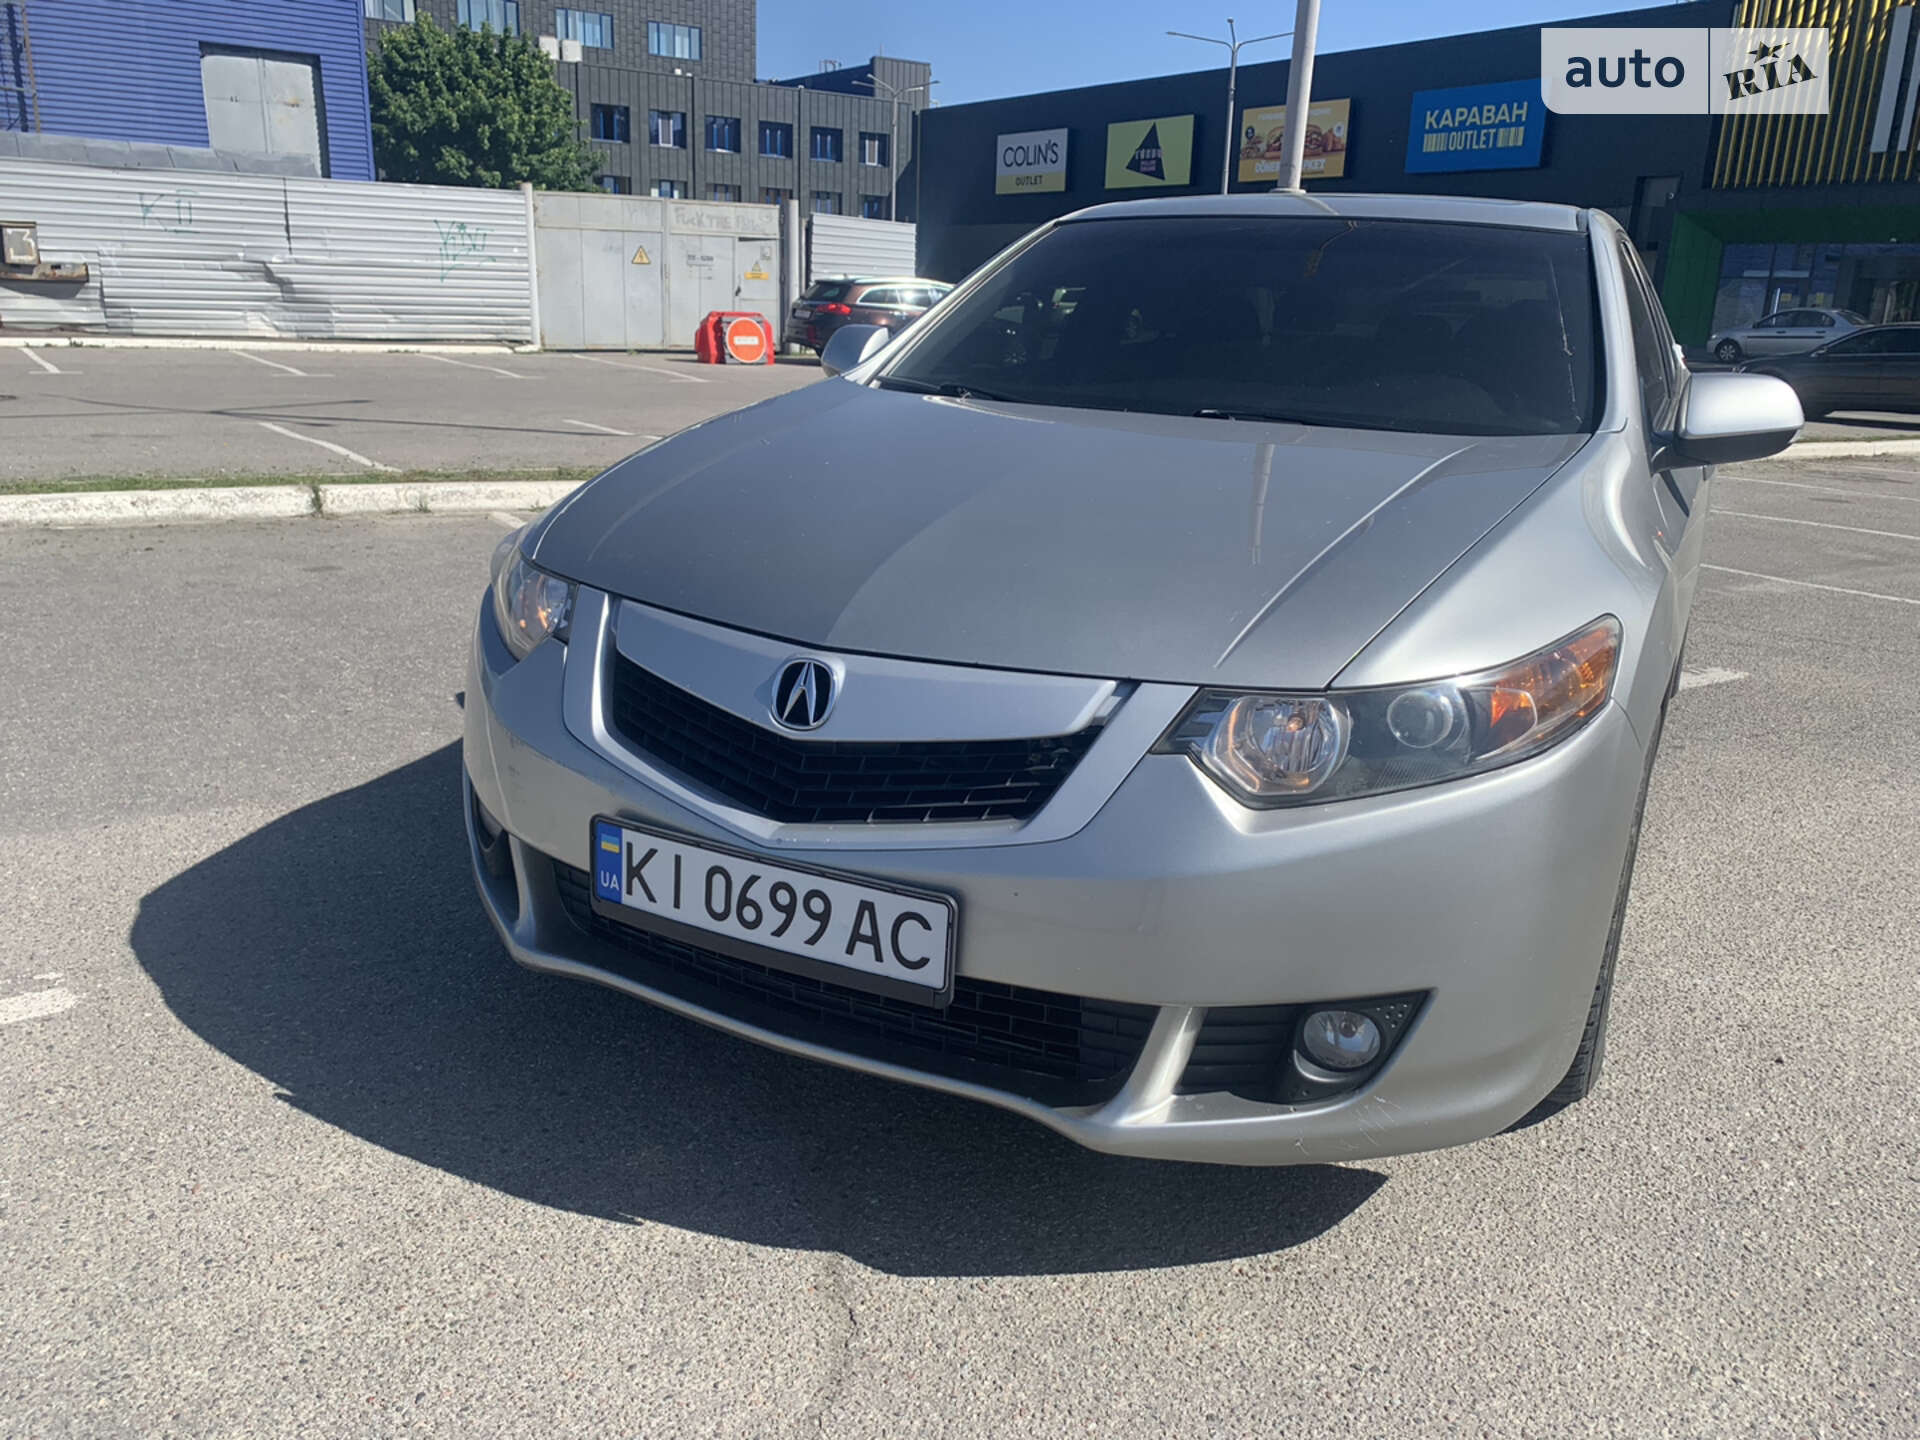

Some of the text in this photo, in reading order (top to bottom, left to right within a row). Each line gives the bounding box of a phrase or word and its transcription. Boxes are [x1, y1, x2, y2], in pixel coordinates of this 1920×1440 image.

[1425, 101, 1528, 130] КАРАВАН
[1448, 128, 1497, 151] OUTLET
[1003, 139, 1059, 168] COLIN'S
[1015, 175, 1043, 186] OUTLET
[600, 869, 620, 891] UA
[704, 865, 832, 947] 0699
[845, 899, 933, 970] AC
